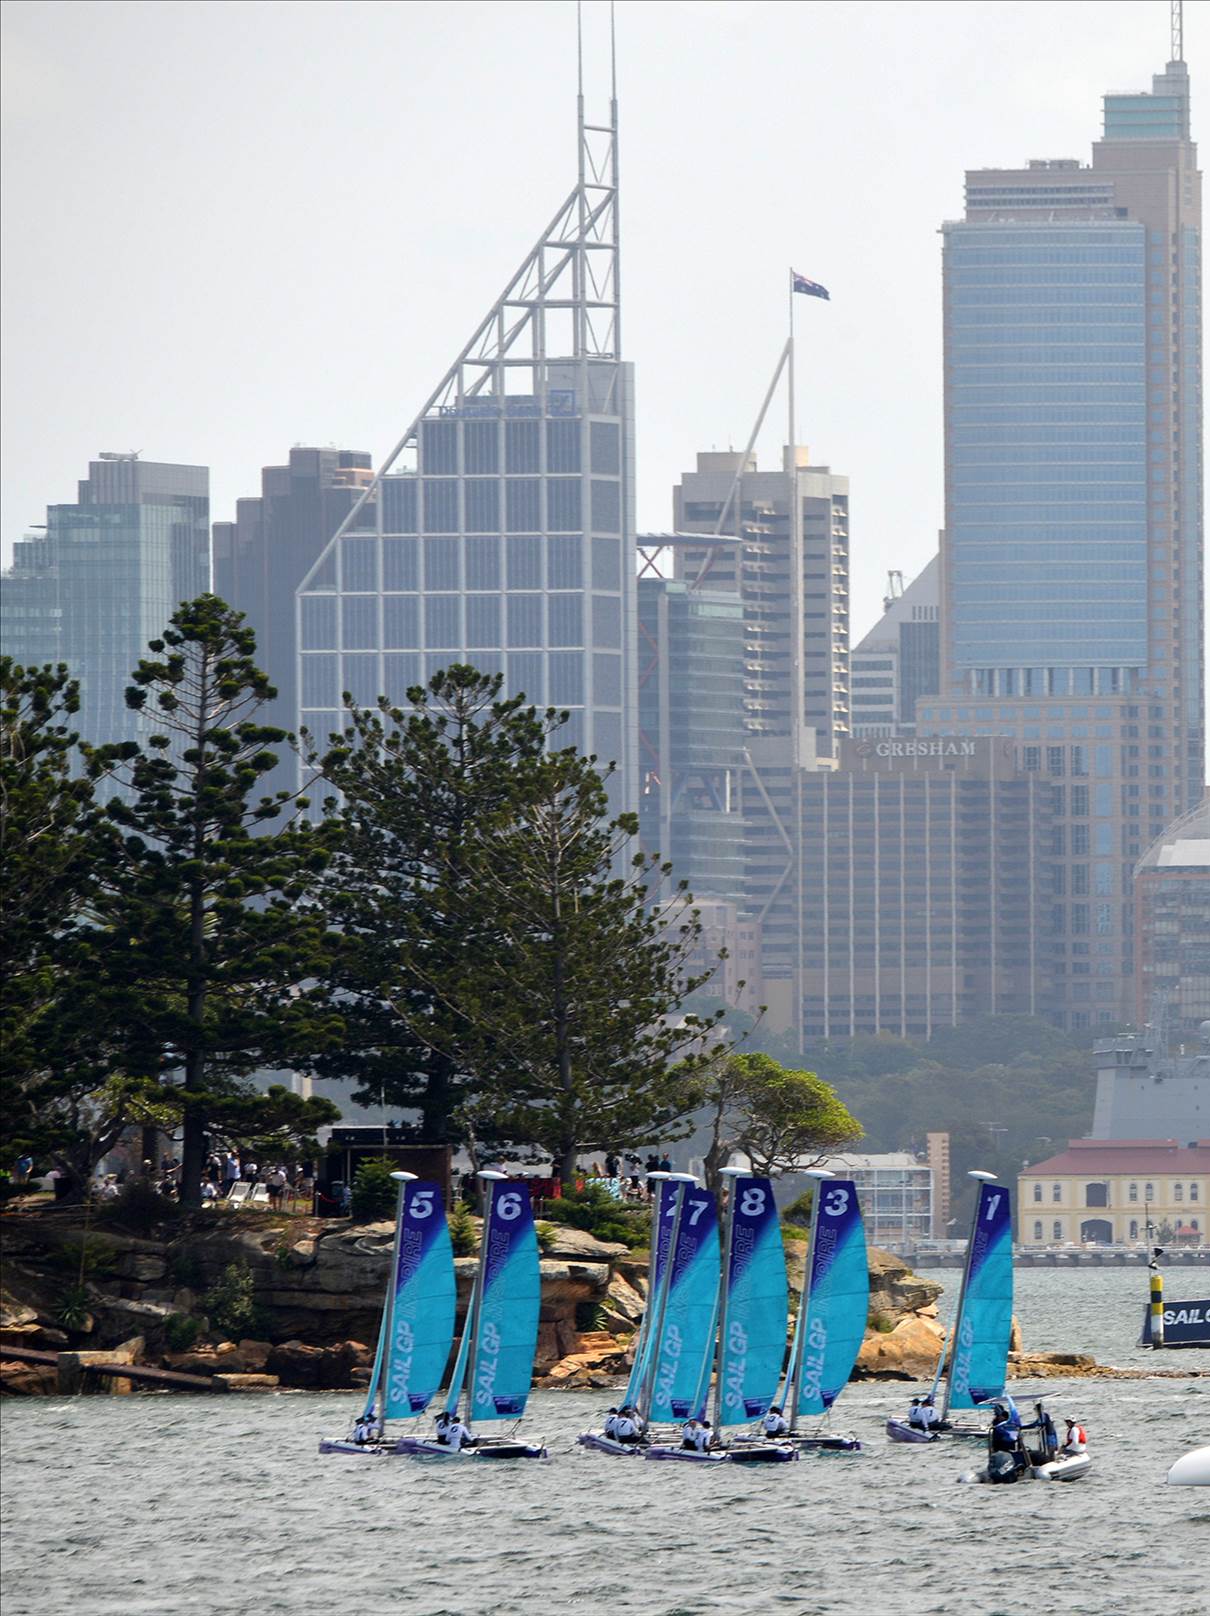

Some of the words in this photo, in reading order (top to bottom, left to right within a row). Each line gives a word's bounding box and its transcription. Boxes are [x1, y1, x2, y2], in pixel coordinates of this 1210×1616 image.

[876, 742, 976, 757] GRESHAM
[409, 1191, 434, 1219] 5
[496, 1192, 522, 1220] 6
[688, 1199, 708, 1225] 7
[740, 1188, 767, 1216] 8
[824, 1189, 850, 1216] 3
[986, 1194, 1001, 1220] 1
[396, 1320, 415, 1352] GP
[481, 1322, 500, 1354] GP
[664, 1324, 683, 1357] GP
[729, 1321, 748, 1354] GP
[808, 1318, 827, 1350] GP
[960, 1317, 976, 1348] GP
[390, 1354, 413, 1405] SAIL
[476, 1356, 498, 1407] SAIL
[656, 1359, 679, 1409] SAIL
[725, 1356, 747, 1409] SAIL
[803, 1353, 825, 1400] SAIL
[954, 1352, 973, 1395] SAIL
